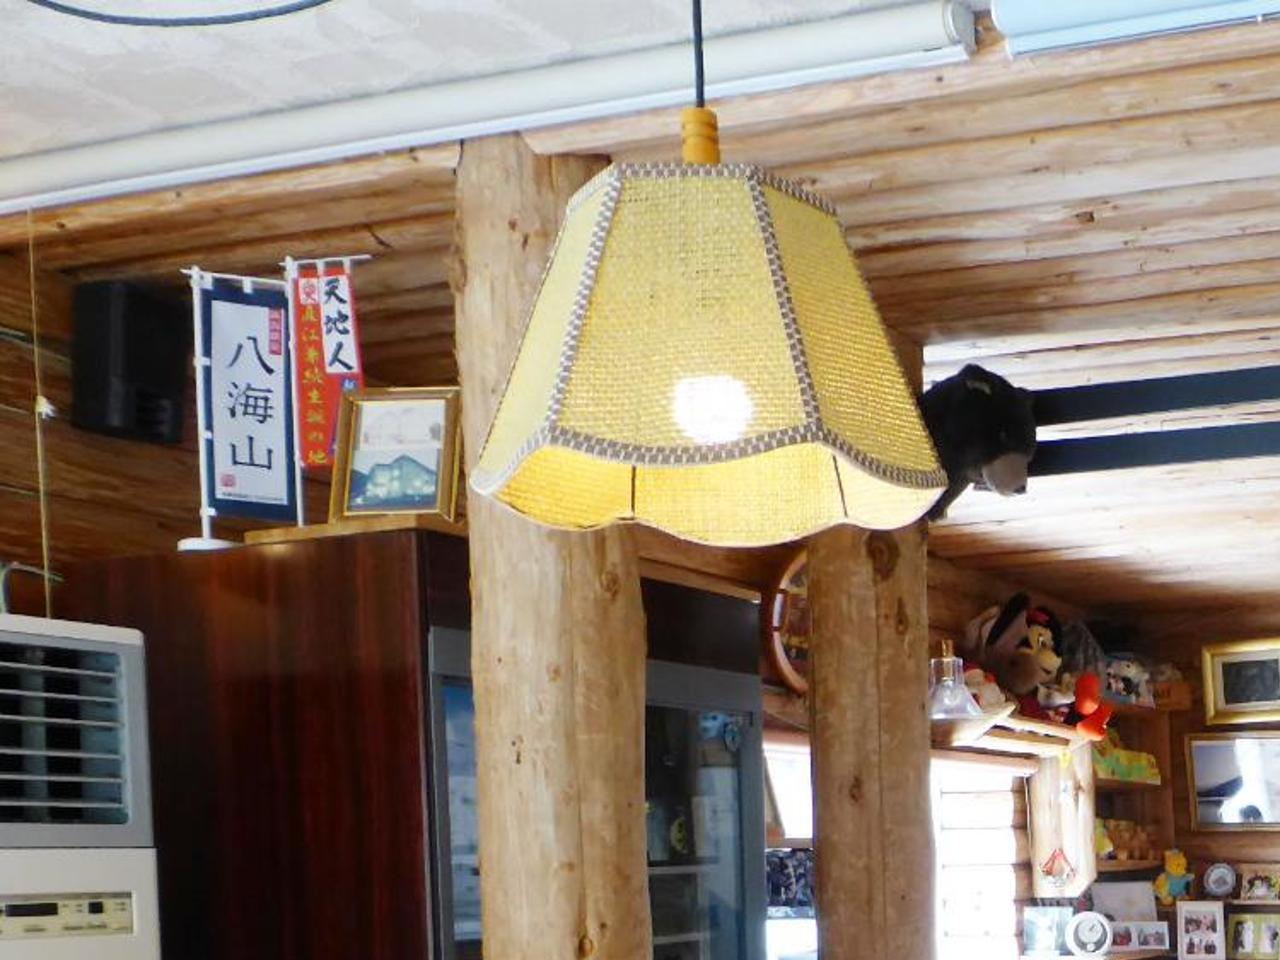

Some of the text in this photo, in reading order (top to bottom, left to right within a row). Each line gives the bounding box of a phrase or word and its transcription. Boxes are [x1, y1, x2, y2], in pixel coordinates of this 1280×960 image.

[323, 278, 355, 371] 天地人
[226, 335, 275, 471] 八海山
